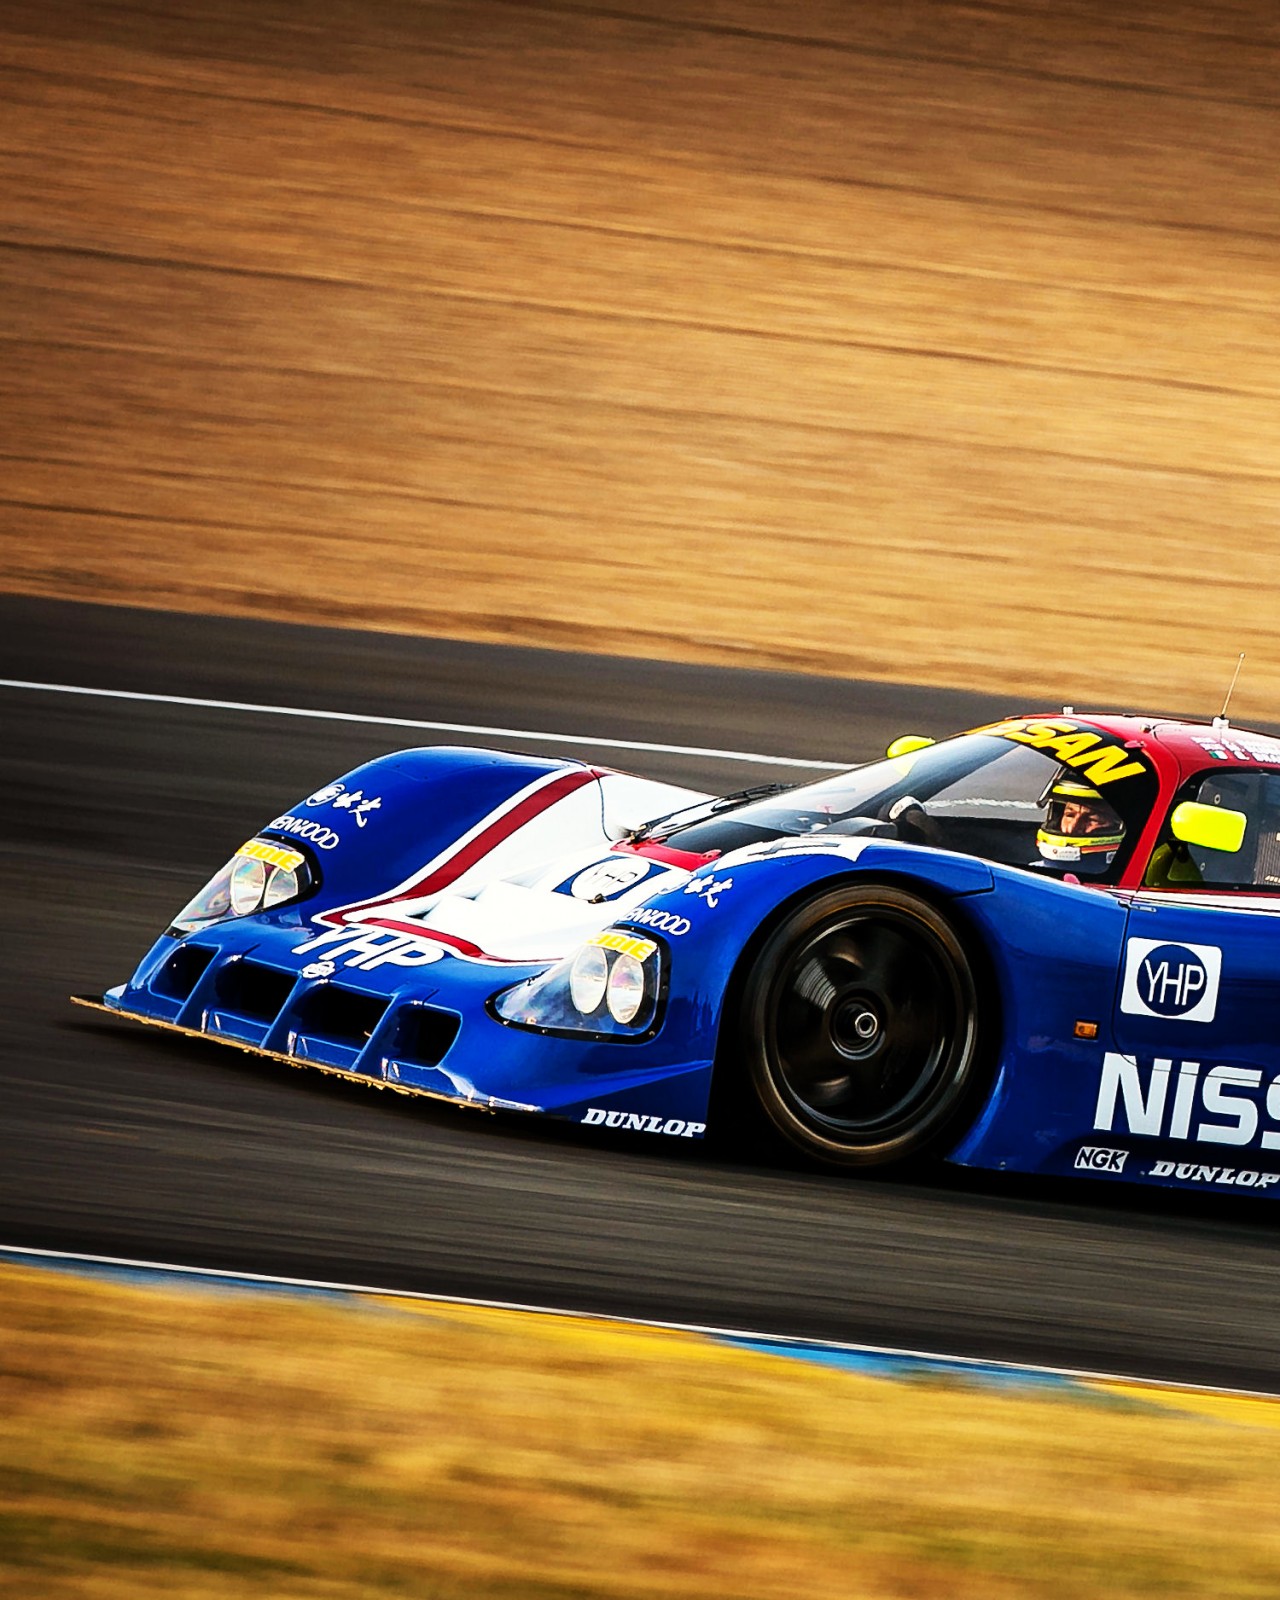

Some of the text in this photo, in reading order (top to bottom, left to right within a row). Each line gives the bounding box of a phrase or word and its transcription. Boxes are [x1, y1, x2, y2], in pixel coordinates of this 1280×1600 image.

[621, 907, 692, 937] ENWOOD
[291, 922, 446, 971] YHP
[1143, 958, 1204, 1007] YHP
[580, 1107, 707, 1138] DUNLOP
[1076, 1148, 1127, 1172] NGK
